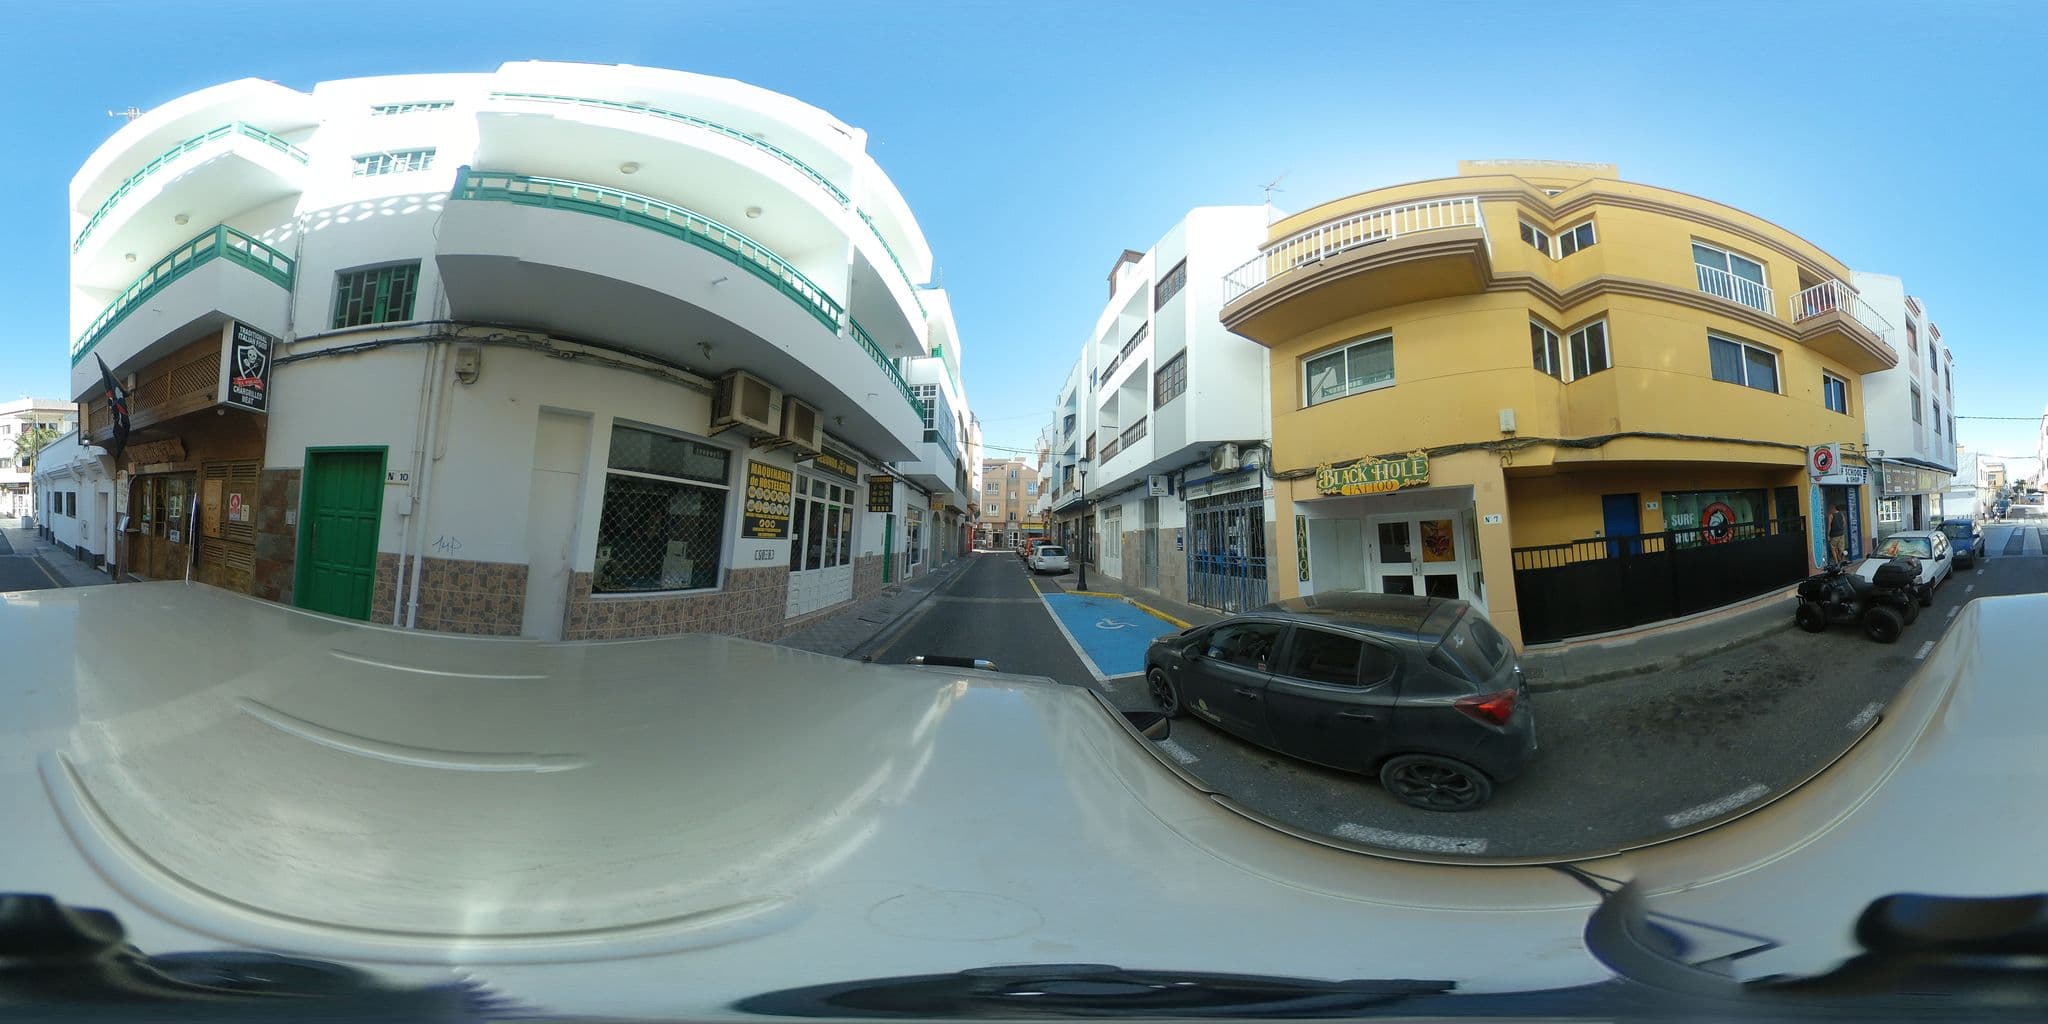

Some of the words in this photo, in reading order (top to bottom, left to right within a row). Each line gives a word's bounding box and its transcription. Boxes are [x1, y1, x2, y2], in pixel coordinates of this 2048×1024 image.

[238, 333, 255, 347] ITALIAN
[256, 340, 267, 350] FOOD
[400, 473, 409, 481] 10
[751, 462, 792, 481] MAQUINARIA
[1319, 465, 1368, 488] BLACK
[1371, 460, 1425, 481] HOLE
[1845, 468, 1862, 477] SCHOOL
[1348, 481, 1395, 494] TATTOO
[1671, 513, 1695, 527] SURF
[1297, 515, 1309, 581] TATTOO
